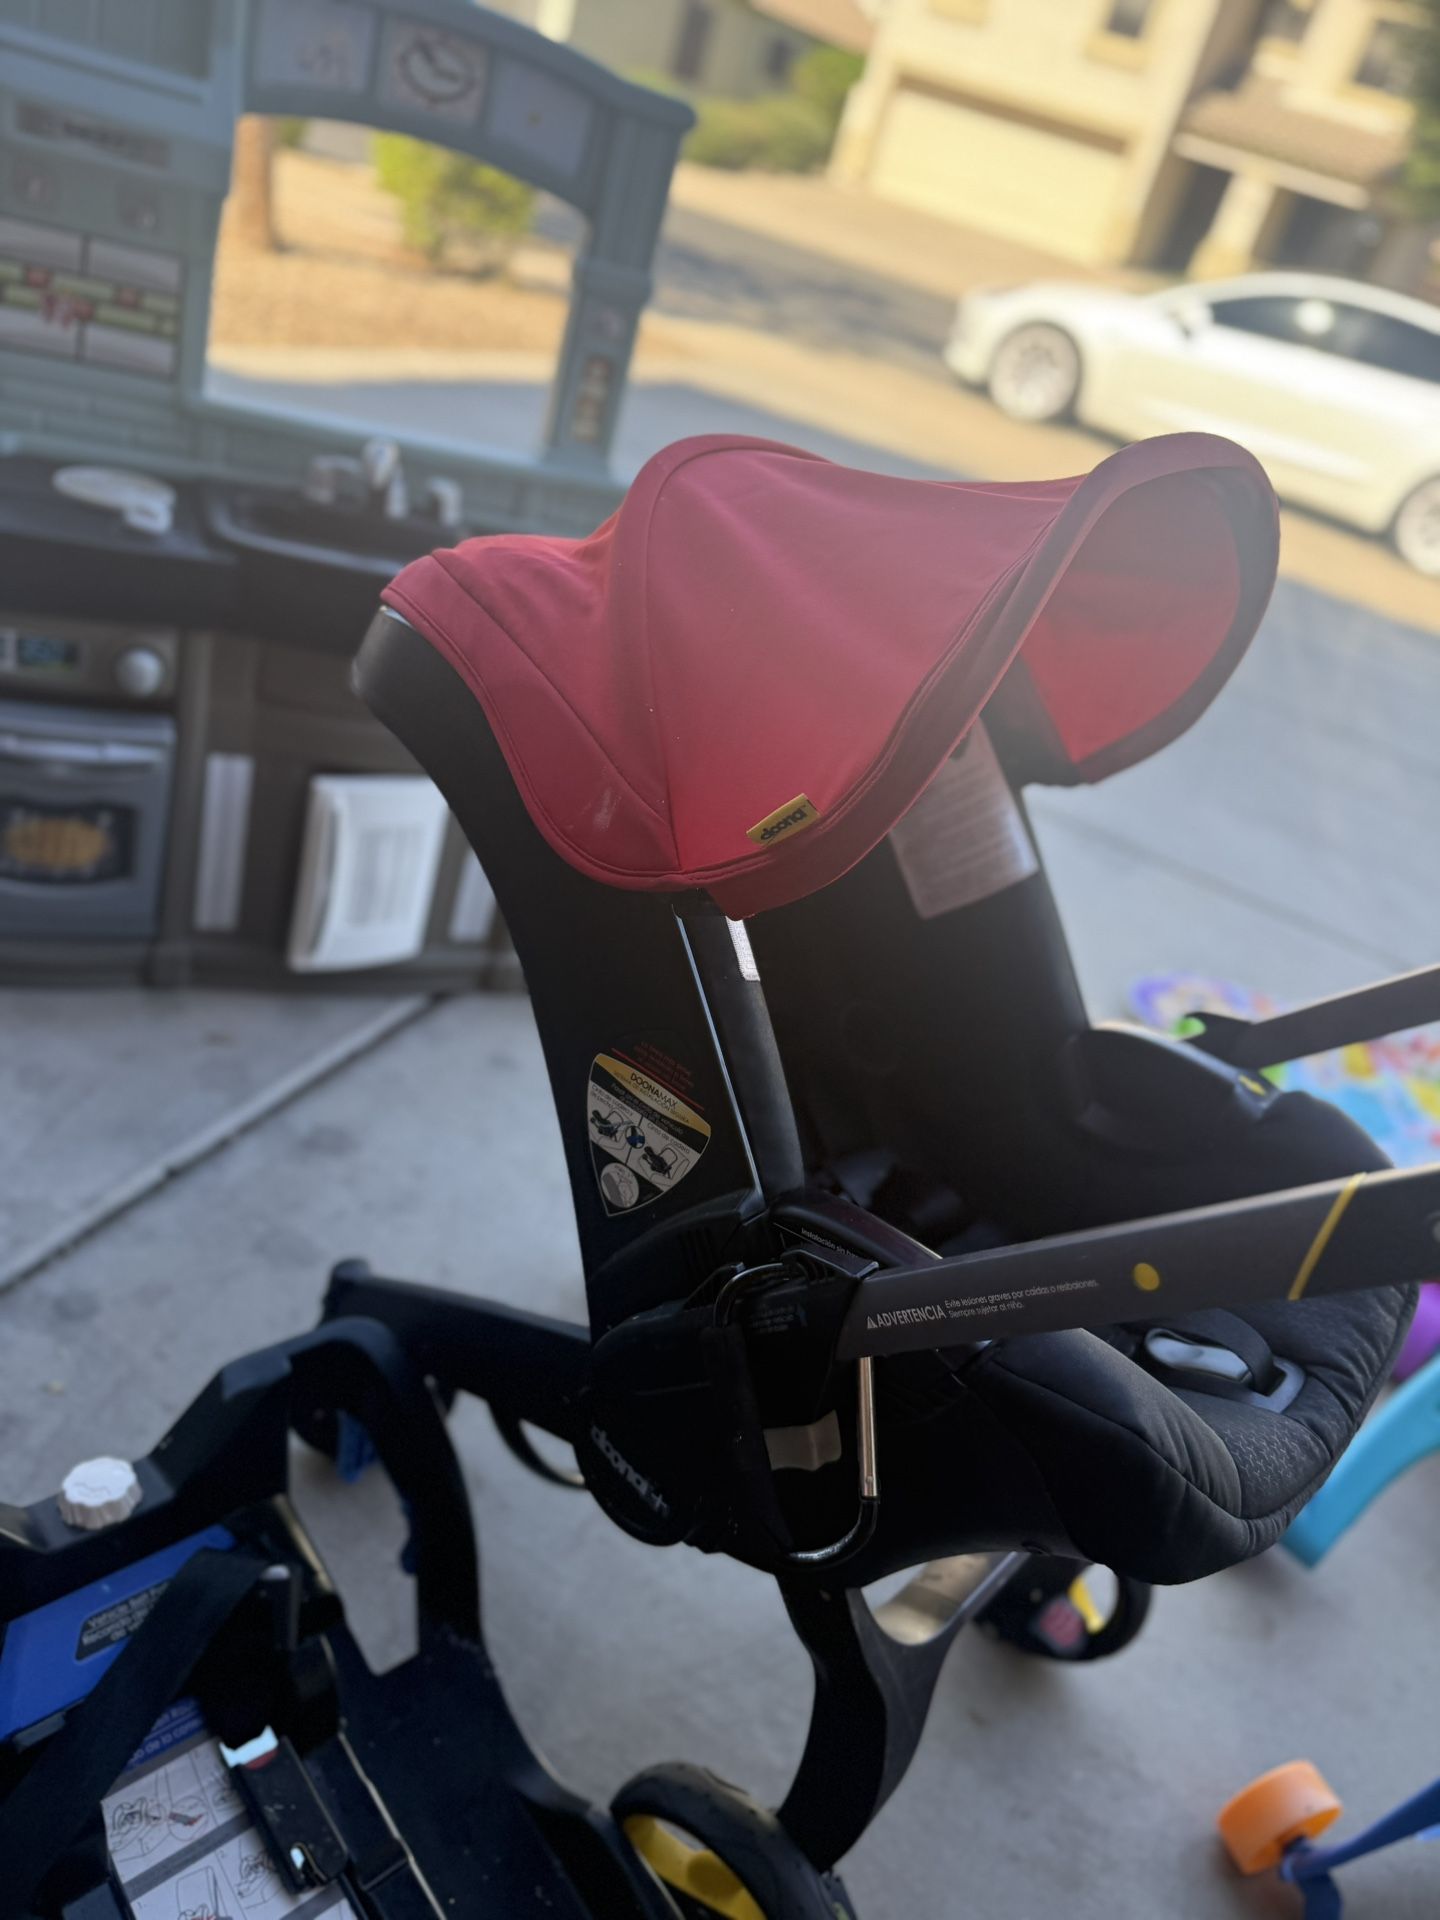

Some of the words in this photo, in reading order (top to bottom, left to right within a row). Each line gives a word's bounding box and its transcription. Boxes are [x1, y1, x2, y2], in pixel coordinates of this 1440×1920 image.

[761, 806, 808, 841] doona
[630, 1072, 679, 1109] DOONAMAX
[944, 1299, 961, 1309] Evite
[961, 1296, 987, 1306] lesiones
[988, 1292, 1011, 1304] graves
[1012, 1290, 1024, 1300] por
[877, 1304, 947, 1328] ADVERTENCIA
[948, 1309, 976, 1318] Siempre
